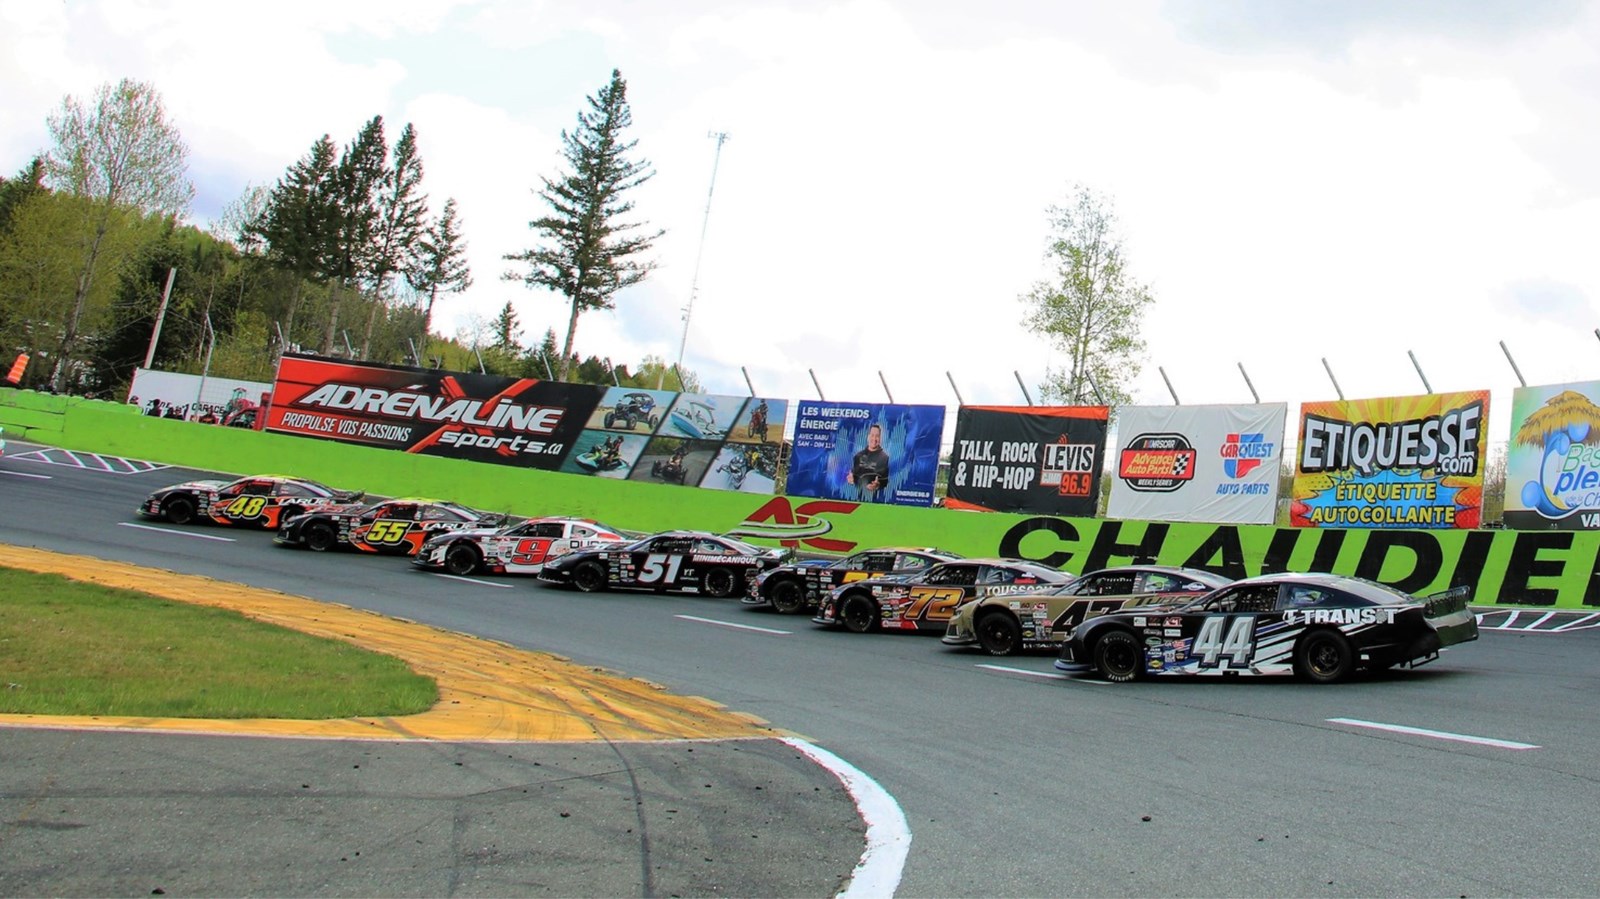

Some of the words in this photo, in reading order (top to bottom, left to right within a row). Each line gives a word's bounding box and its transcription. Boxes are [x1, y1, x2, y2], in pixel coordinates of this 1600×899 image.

[800, 417, 839, 430] ÉNERGIE
[802, 407, 818, 416] LES
[822, 407, 869, 418] WEEKENDS
[281, 412, 336, 432] PROPULSE
[338, 420, 359, 435] VOS
[359, 423, 412, 442] PASSIONS
[1149, 440, 1176, 448] NASCAR
[1220, 443, 1274, 459] CARQUEST
[1303, 405, 1480, 473] ETIQUESSE
[1437, 456, 1473, 474] .com
[959, 440, 995, 465] TALK,
[1001, 441, 1039, 463] ROCK
[1043, 446, 1093, 471] LEVIS
[1132, 453, 1173, 464] Advance
[954, 462, 967, 486] &
[971, 465, 1035, 490] HIP-HOP
[1125, 465, 1147, 474] Auto
[1147, 465, 1170, 475] Parts
[1061, 474, 1091, 494] 96.9
[1137, 478, 1156, 486] WEEKLY
[1216, 484, 1239, 495] AUTO
[1240, 484, 1270, 495] PARTS
[1336, 480, 1437, 503] ÉTIQUETTE
[225, 495, 266, 518] 48
[1310, 506, 1455, 524] AUTOCOLLANTE
[366, 521, 410, 543] 55
[511, 538, 553, 565] 9
[693, 554, 757, 565] MINIMÉCANIQUE
[998, 516, 1600, 607] CHAUDIE
[637, 554, 683, 584] 51
[904, 586, 965, 620] 72
[1050, 599, 1131, 632] 47
[1193, 616, 1255, 664] 44
